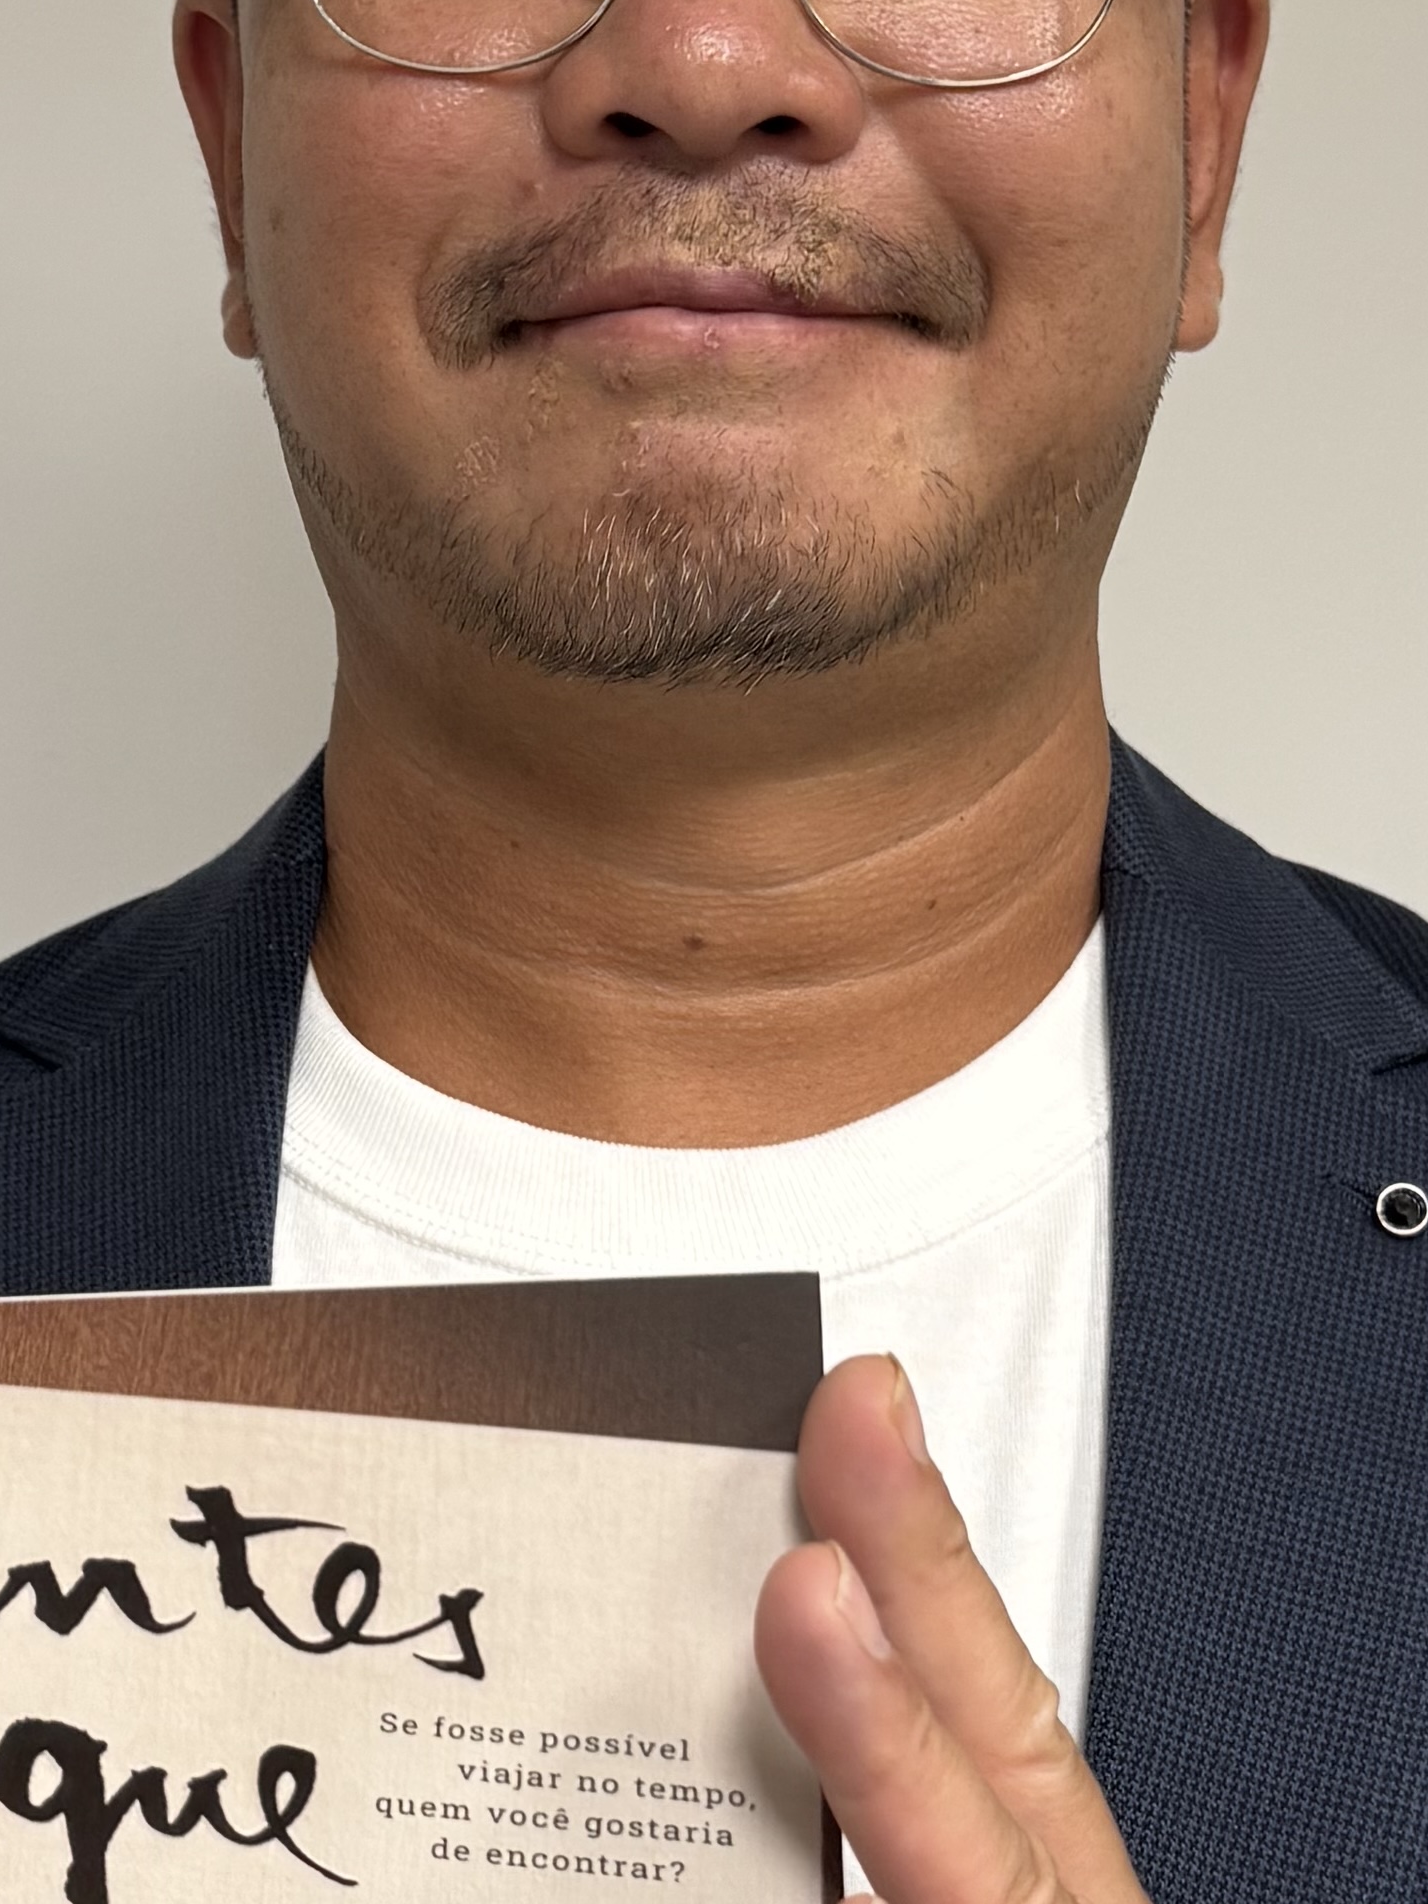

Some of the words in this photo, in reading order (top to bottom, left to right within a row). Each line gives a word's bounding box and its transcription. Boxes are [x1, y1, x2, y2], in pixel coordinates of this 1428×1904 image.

[378, 1712, 419, 1737] Se
[432, 1716, 526, 1746] fosse
[539, 1732, 691, 1763] possível
[457, 1759, 563, 1792] viajar
[576, 1774, 621, 1796] no
[634, 1777, 757, 1813] tempo,
[375, 1796, 471, 1822] quem
[487, 1806, 571, 1832] você
[584, 1816, 735, 1848] gostaria
[430, 1836, 472, 1863] de
[484, 1848, 686, 1884] encontrar?
